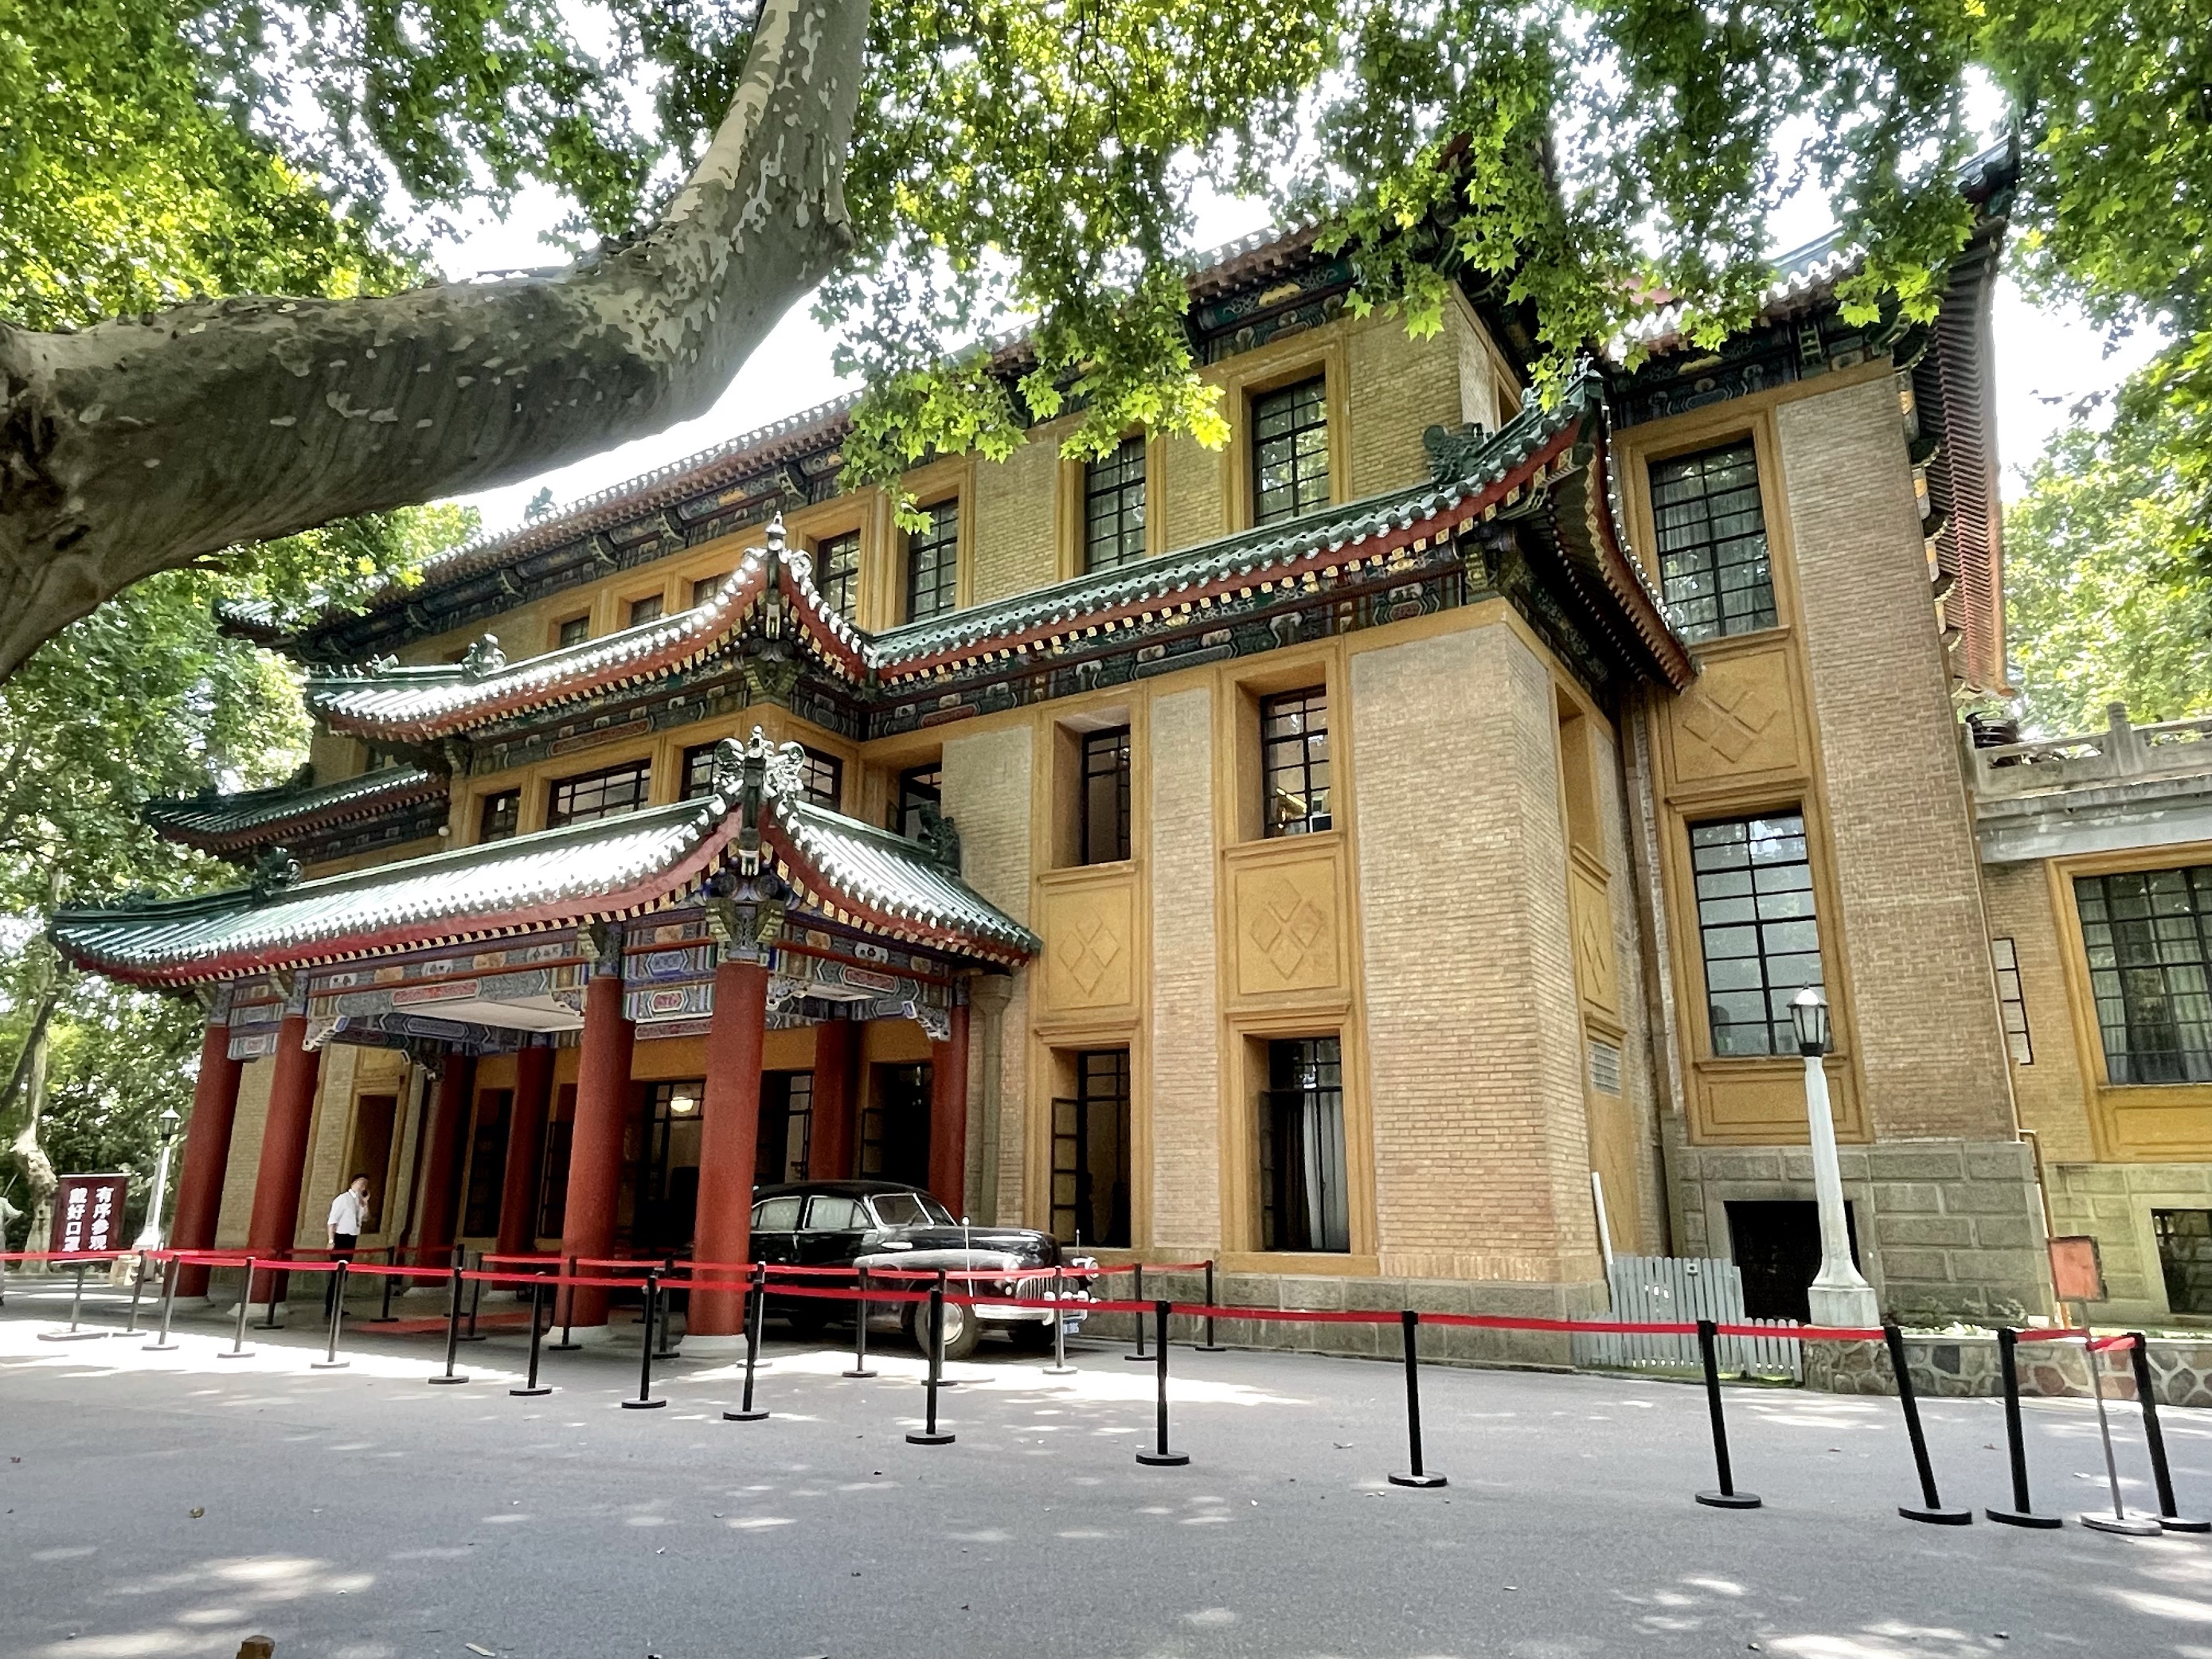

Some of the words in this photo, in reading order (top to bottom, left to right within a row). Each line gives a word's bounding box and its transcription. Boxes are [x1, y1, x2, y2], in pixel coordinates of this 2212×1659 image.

[62, 1187, 88, 1252] 戴好口罩
[88, 1186, 114, 1251] 有序参观
